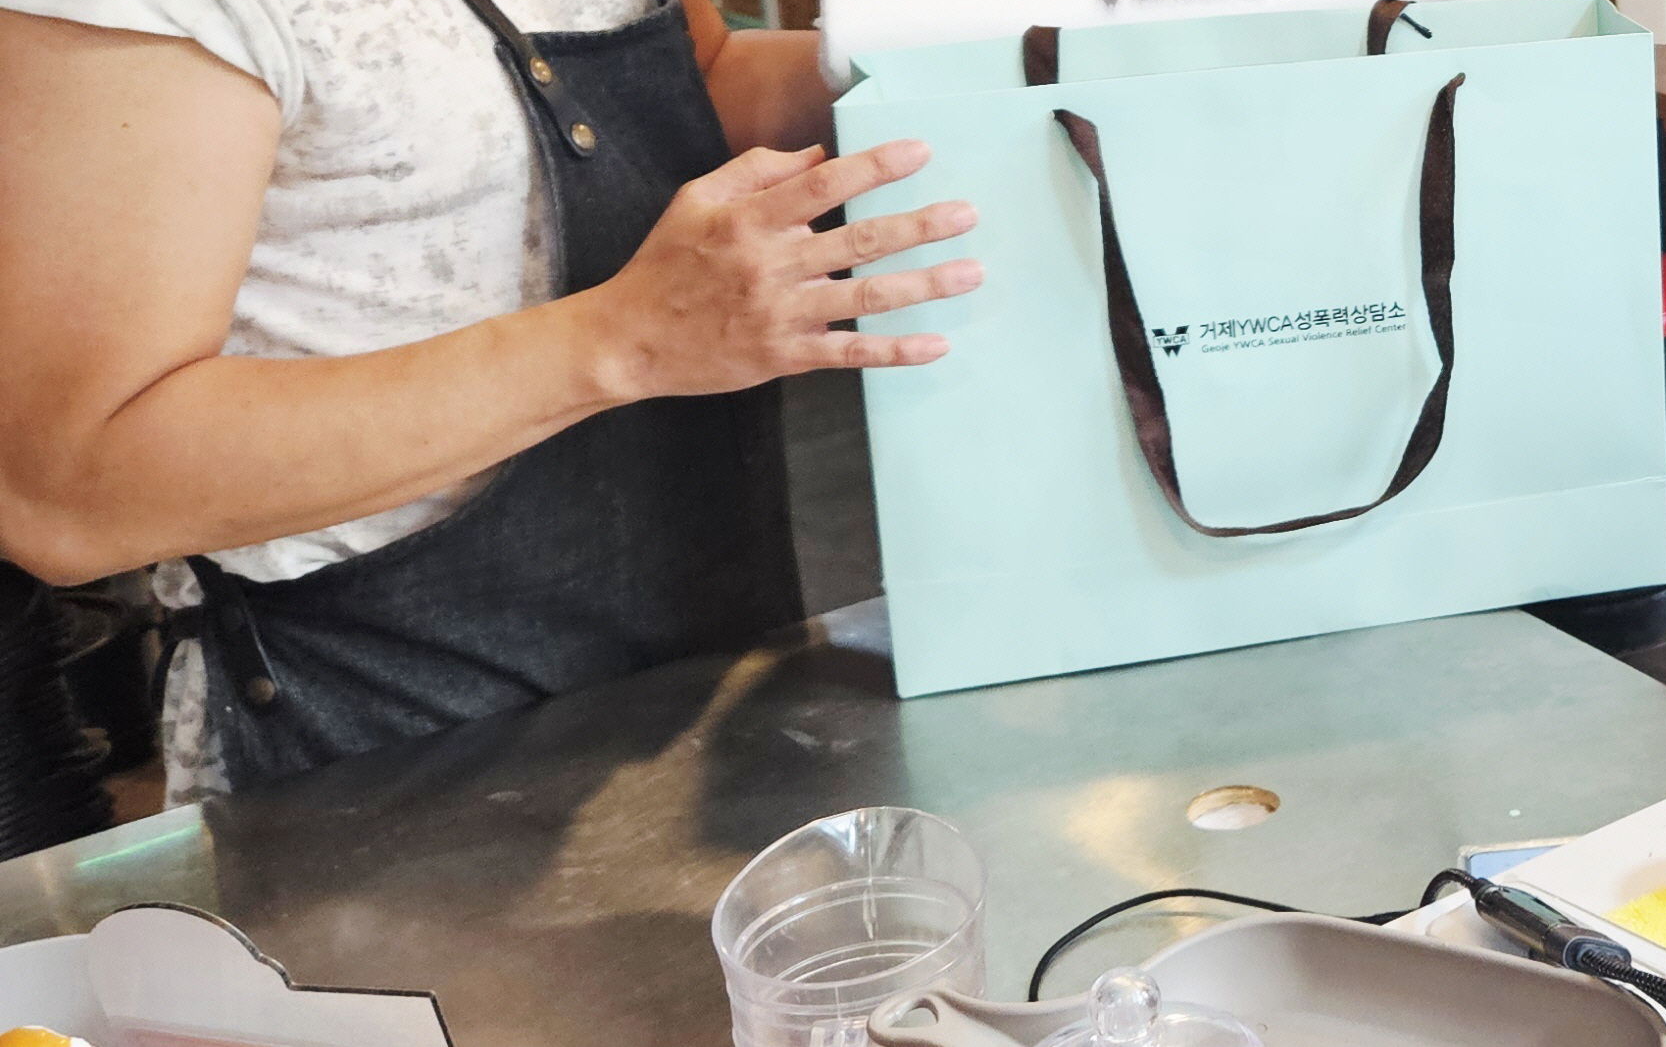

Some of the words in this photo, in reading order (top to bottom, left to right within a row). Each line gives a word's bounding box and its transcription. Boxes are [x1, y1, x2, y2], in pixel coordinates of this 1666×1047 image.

[1199, 301, 1407, 341] 거제YWCA성폭력상담소
[1156, 335, 1187, 345] YWCA
[1201, 344, 1230, 354] Geoje
[1233, 339, 1265, 349] YWCA
[1268, 334, 1300, 346] Sexual
[1302, 331, 1344, 342] Violence
[1345, 326, 1373, 337] Relief
[1375, 323, 1407, 334] Center
